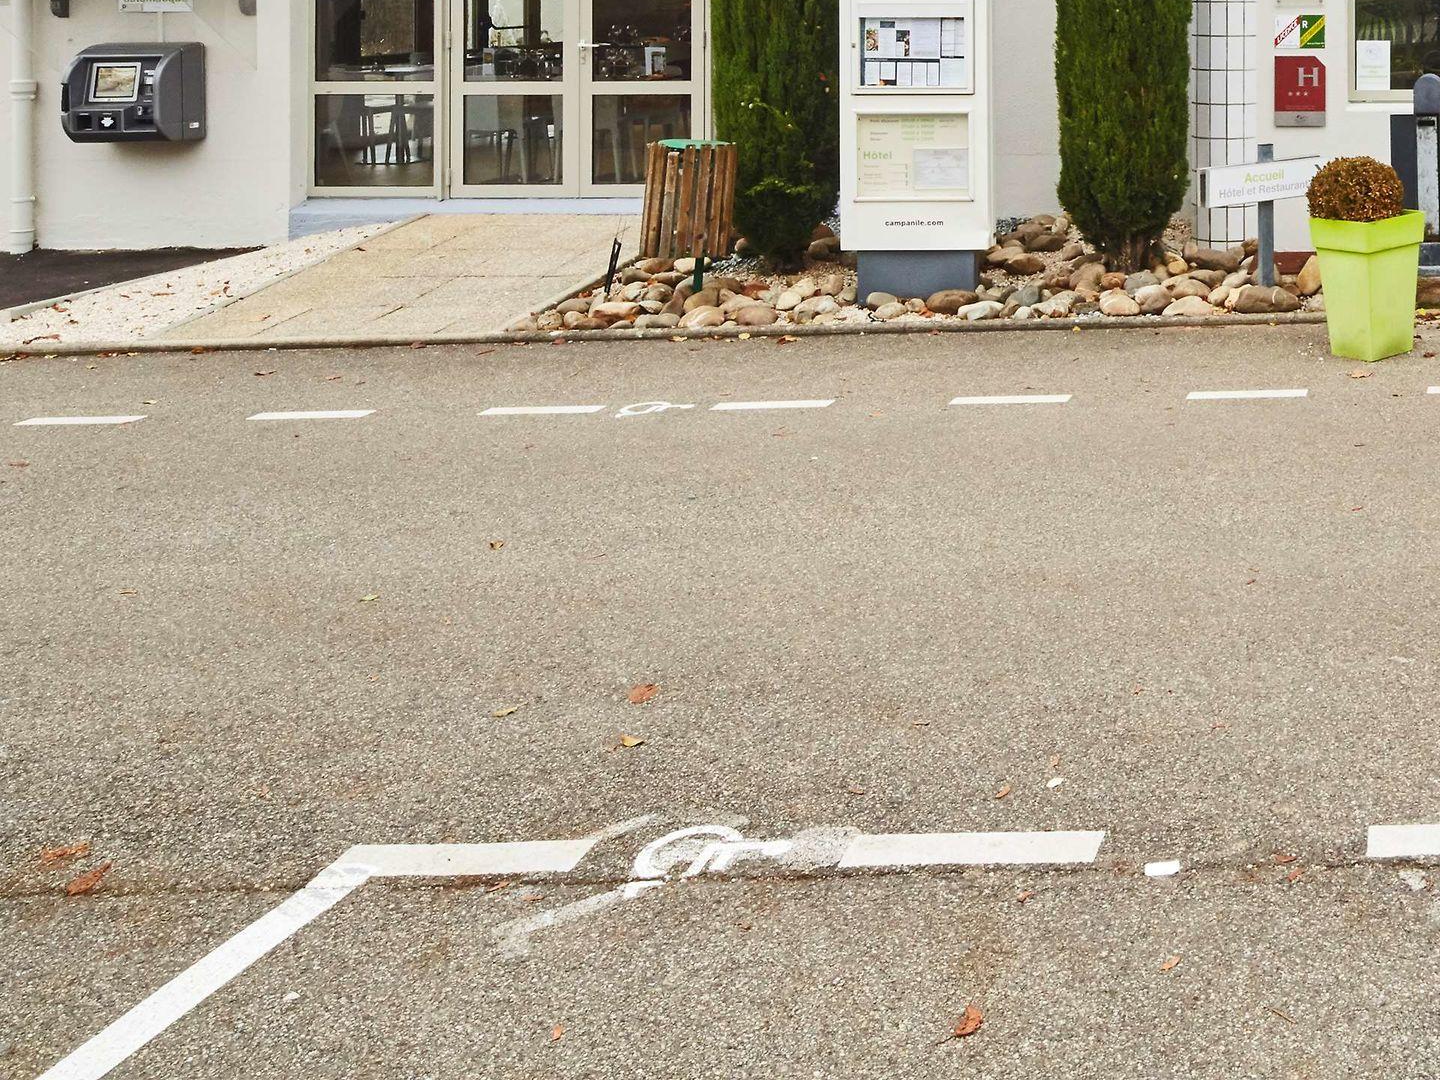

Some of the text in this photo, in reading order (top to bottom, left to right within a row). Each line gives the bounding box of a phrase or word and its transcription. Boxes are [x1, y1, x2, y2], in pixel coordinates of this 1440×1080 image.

[1302, 20, 1308, 29] R
[1298, 67, 1319, 87] H
[1244, 169, 1284, 183] Accueil
[1246, 186, 1256, 196] et
[884, 219, 944, 227] campanile.com
